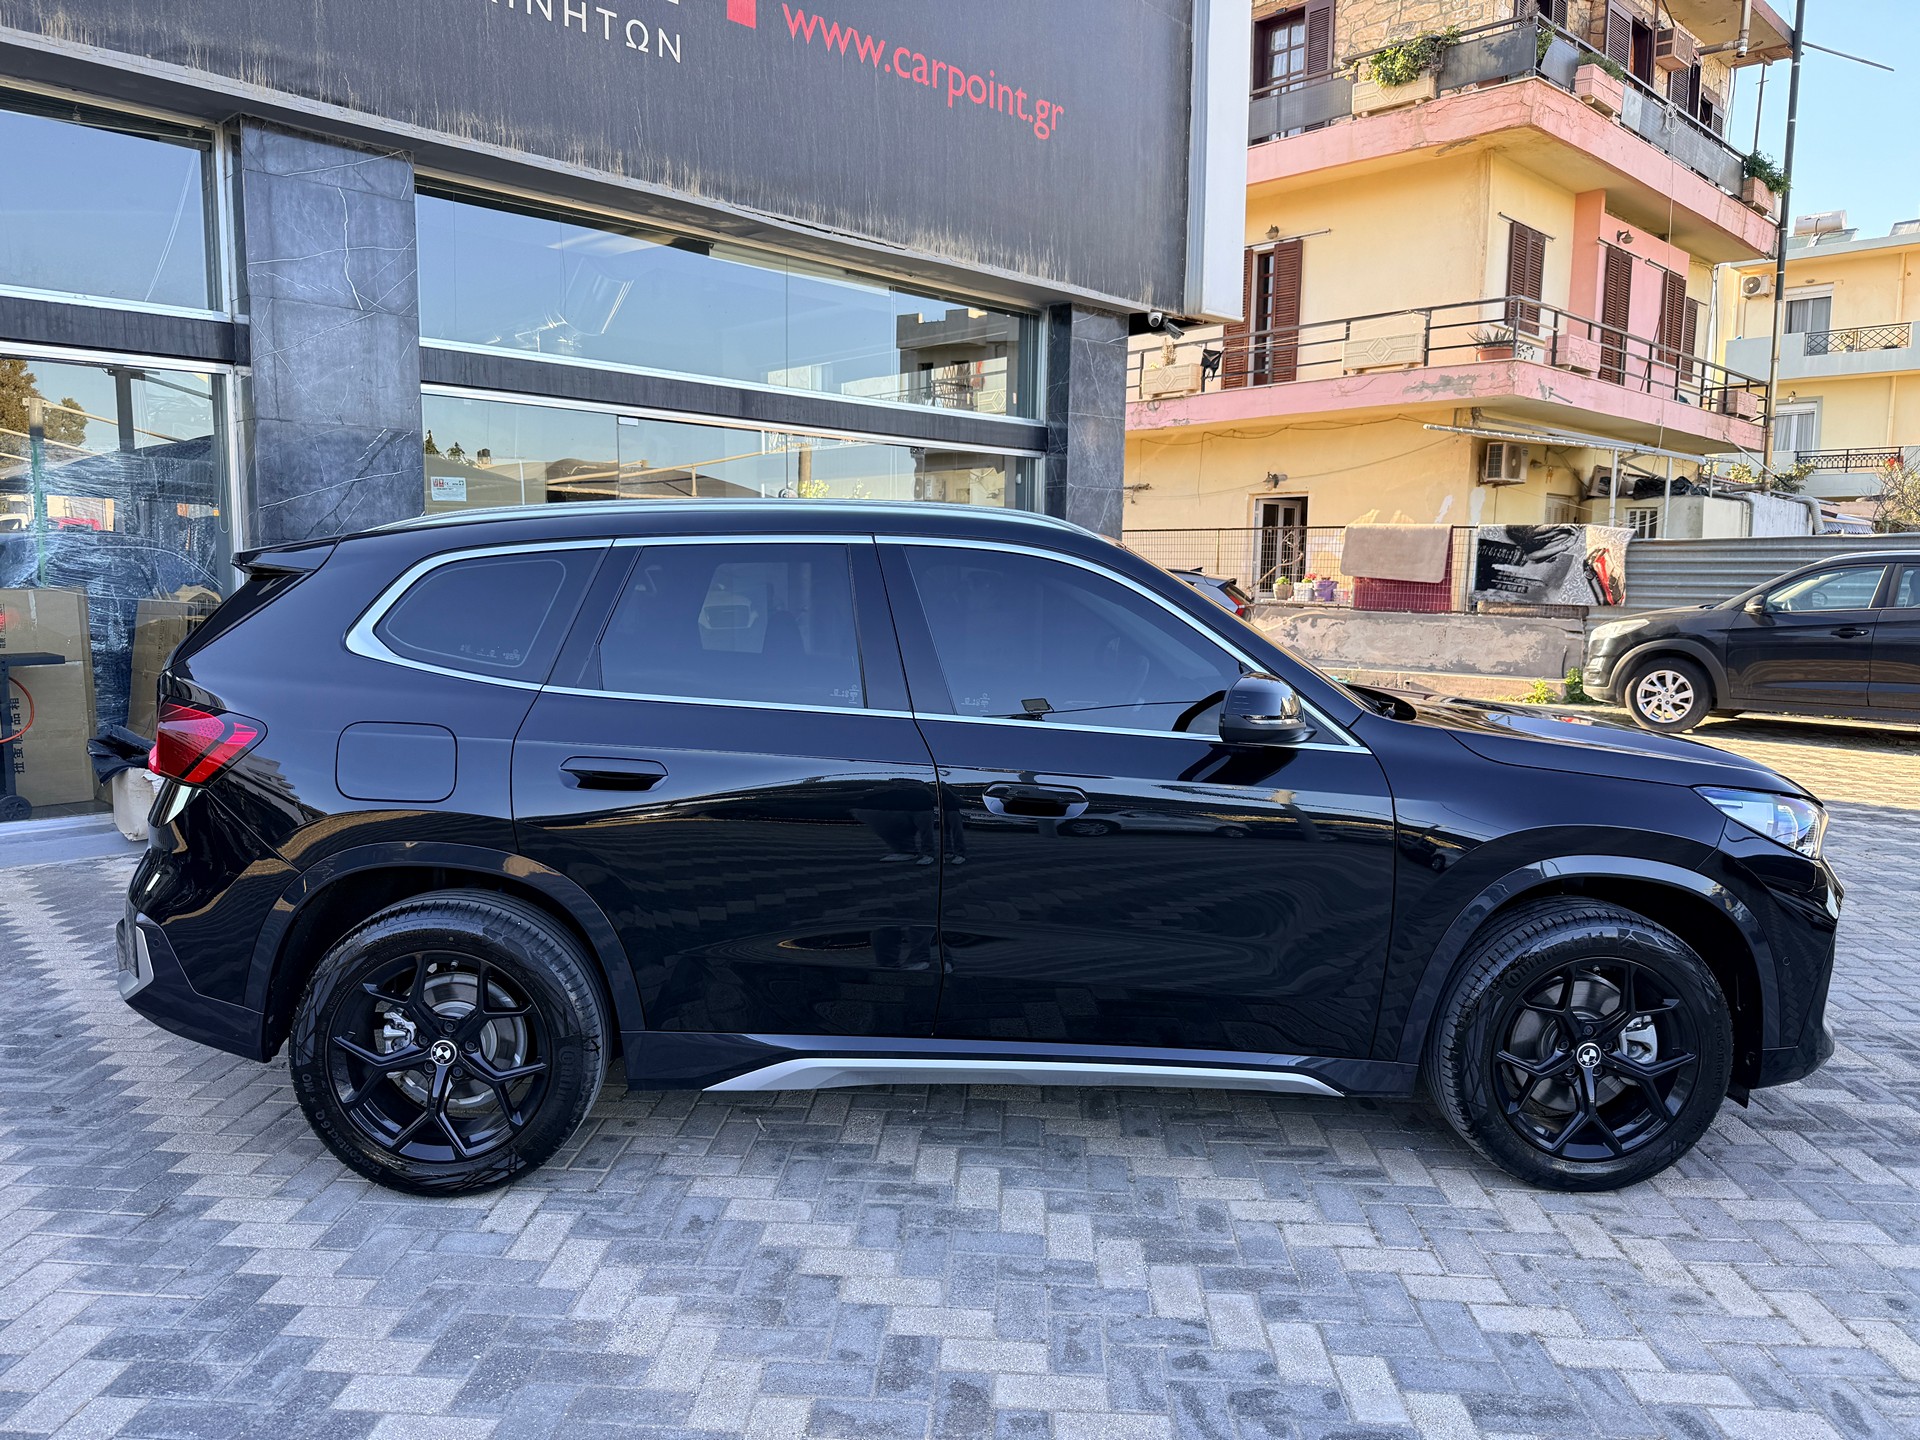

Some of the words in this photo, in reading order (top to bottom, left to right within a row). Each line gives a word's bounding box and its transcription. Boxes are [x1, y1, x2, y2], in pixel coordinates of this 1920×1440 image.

[781, 2, 1065, 140] www.carpoint.gr
[301, 1073, 316, 1092] MO
[320, 1120, 331, 1129] 6
[327, 1127, 383, 1175] EcoContact
